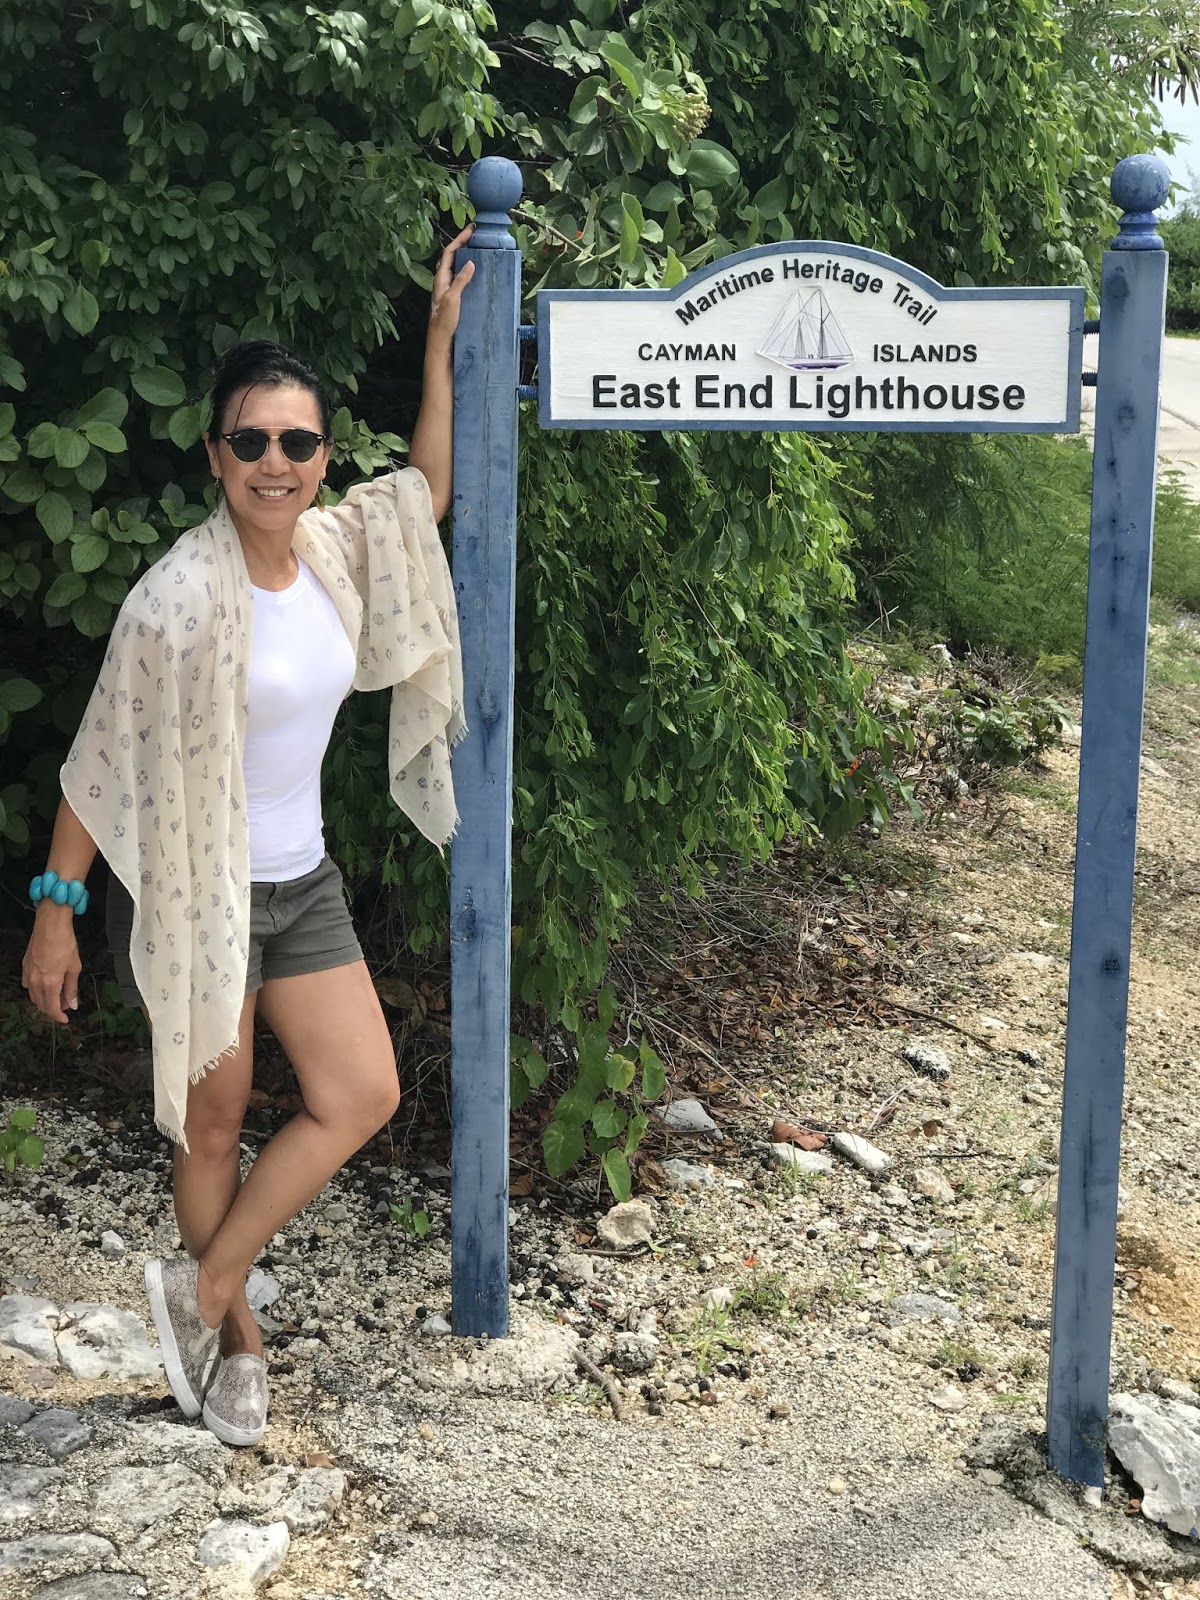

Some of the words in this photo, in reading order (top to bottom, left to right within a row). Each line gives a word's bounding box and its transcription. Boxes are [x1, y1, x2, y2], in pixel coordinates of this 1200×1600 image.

[675, 267, 774, 326] Maritime
[782, 258, 884, 294] Heritage
[892, 282, 938, 326] Trail
[638, 343, 736, 361] CAYMAN
[873, 343, 978, 363] ISLANDS
[592, 374, 681, 409] East
[695, 374, 773, 409] End
[789, 374, 1026, 419] Lighthouse
